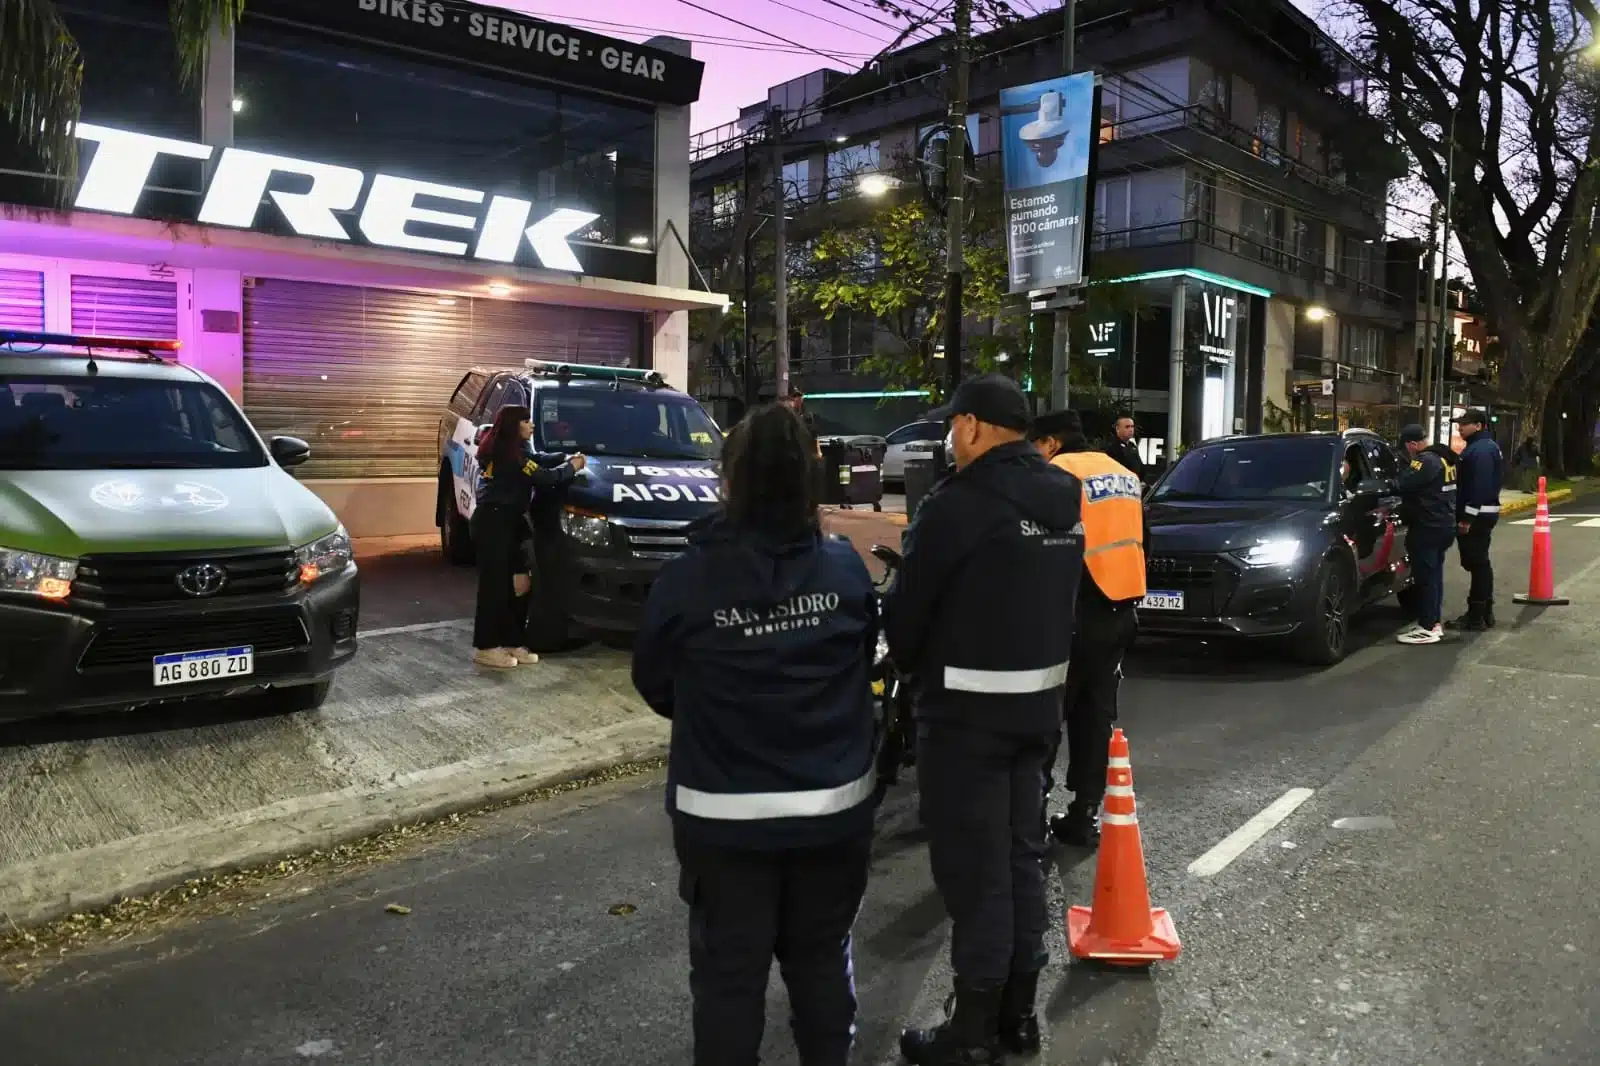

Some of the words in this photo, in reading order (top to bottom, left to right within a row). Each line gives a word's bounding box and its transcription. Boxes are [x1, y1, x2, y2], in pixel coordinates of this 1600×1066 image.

[358, 0, 445, 27] BIKES
[468, 12, 581, 62] SERVICE
[600, 47, 666, 82] GEAR
[41, 117, 600, 273] TREK
[1010, 194, 1056, 209] Estamos
[1011, 204, 1058, 222] sumando
[1011, 222, 1037, 236] 2100
[1038, 215, 1080, 231] cámaras
[1146, 597, 1164, 607] 432
[744, 617, 820, 637] MUNICIPIO
[160, 664, 182, 682] AG
[189, 660, 220, 678] 880
[227, 657, 248, 673] ZD
